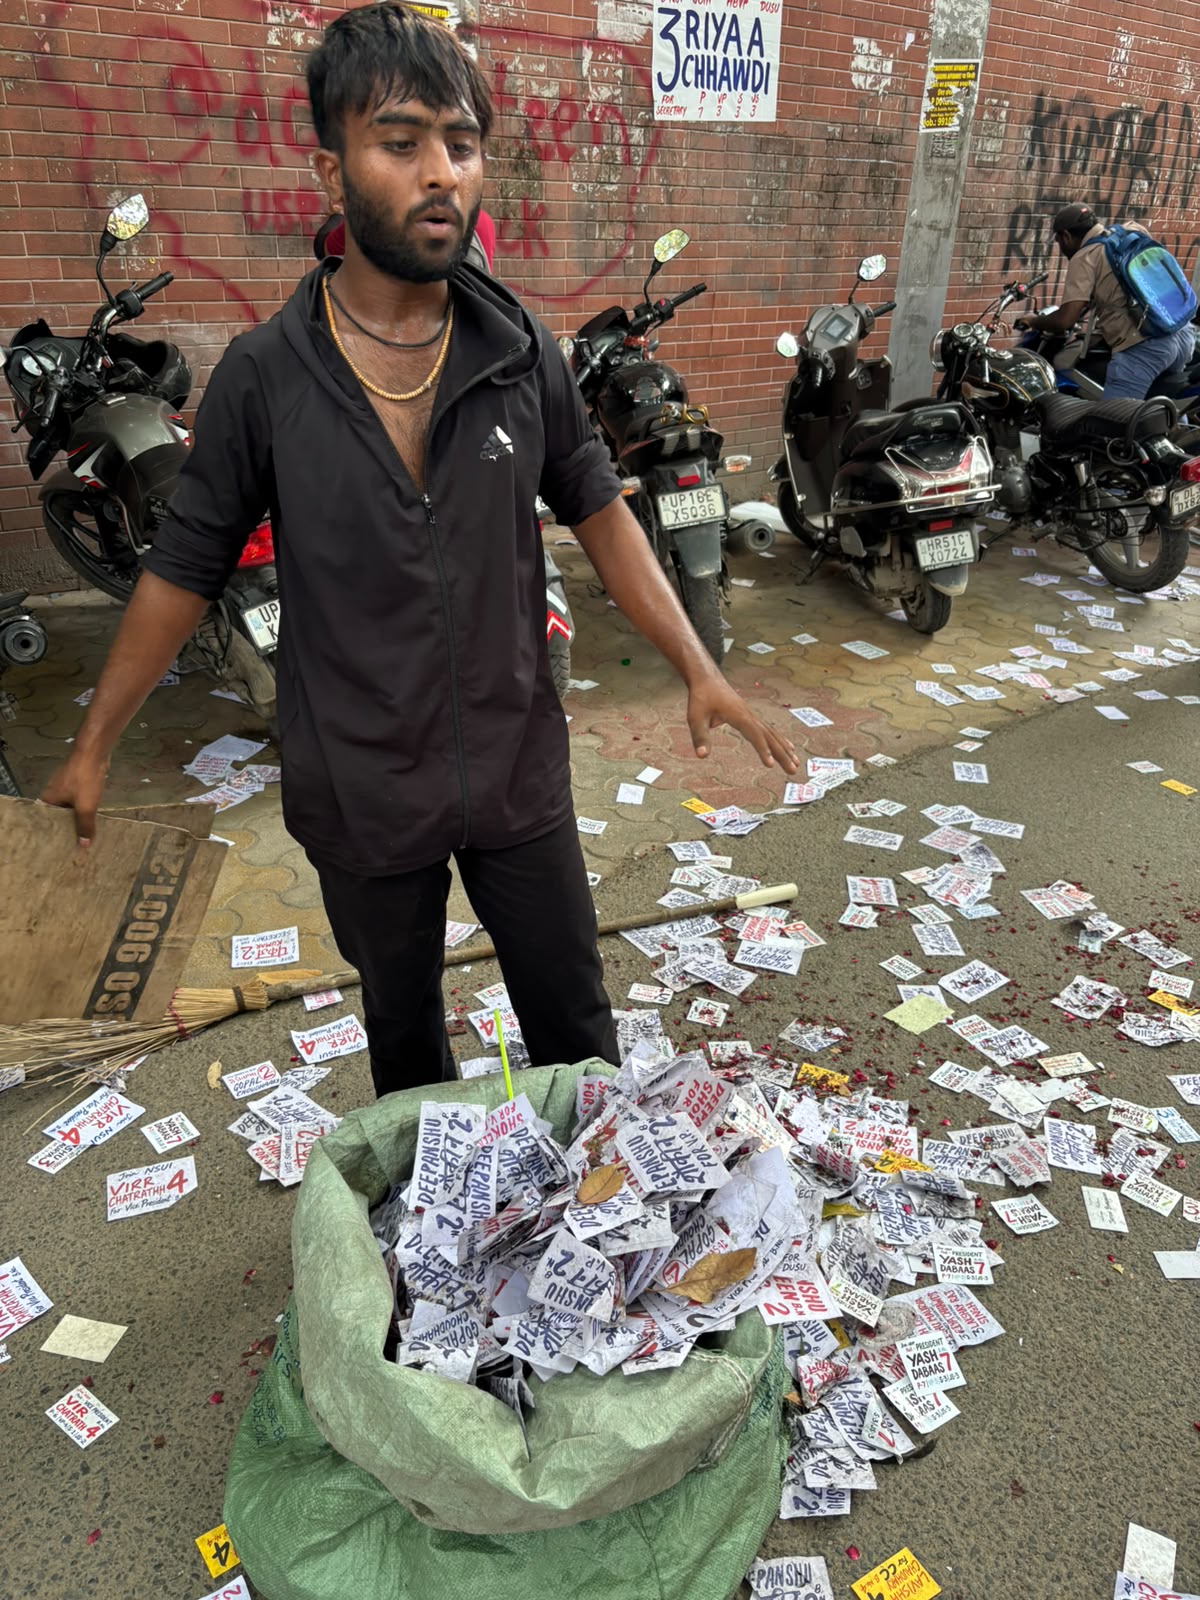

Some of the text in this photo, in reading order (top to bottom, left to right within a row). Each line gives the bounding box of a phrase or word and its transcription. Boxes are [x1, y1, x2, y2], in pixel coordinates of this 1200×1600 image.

[657, 7, 681, 92] 3
[682, 54, 770, 95] CHHAWDI
[661, 95, 674, 104] FOR
[656, 105, 687, 116] SECRETARY
[669, 489, 714, 508] UP16E
[673, 504, 717, 523] X5036
[926, 533, 966, 550] HR51C
[929, 546, 968, 564] X0724
[241, 946, 253, 960] 2
[256, 940, 283, 949] KUMAR
[479, 1019, 494, 1036] 4
[299, 1033, 364, 1055] VIRR 4
[319, 1049, 341, 1060] NSUI
[259, 1066, 274, 1080] 2
[954, 1067, 969, 1077] 3
[233, 1077, 261, 1092] GOPAL
[683, 1079, 700, 1107] FOR
[499, 1102, 516, 1121] FOR
[694, 1082, 725, 1127] DEEPA
[57, 1104, 131, 1146] VIRR 4
[164, 1118, 183, 1136] YASH
[297, 1126, 325, 1138] 2
[448, 1118, 473, 1133] 2
[649, 1115, 677, 1136] 2
[889, 1128, 910, 1137] FOR
[90, 1126, 113, 1145] NSUI
[166, 1135, 183, 1144] 7
[38, 1156, 56, 1168] 3
[417, 1118, 442, 1205] DEEPANSHU
[509, 1127, 549, 1184] DEEPANS
[692, 1145, 717, 1168] FOR
[144, 1162, 173, 1175] NSUI
[980, 1162, 991, 1176] 2
[110, 1169, 188, 1196] VIRR 4
[1135, 1179, 1164, 1196] YASH
[108, 1185, 165, 1208] CHATRATHH
[141, 1195, 171, 1208] President
[435, 1213, 464, 1230] 2
[1005, 1211, 1047, 1225] YASH 7
[679, 1223, 715, 1264] GOPAL
[553, 1249, 575, 1277] 2
[782, 1253, 800, 1262] FOR
[939, 1254, 972, 1266] YASH
[782, 1264, 807, 1272] DUSU
[940, 1262, 985, 1275] DABAAS 7
[764, 1302, 790, 1317] 2
[966, 1301, 990, 1325] SINGH
[446, 1319, 479, 1348] GOPAL
[972, 1327, 985, 1337] 3
[916, 1337, 945, 1351] PRESIDENT
[907, 1349, 939, 1367] YASH
[911, 1352, 952, 1381] DABAAS 7
[66, 1395, 88, 1418] VIR
[56, 1403, 101, 1439] CHATRATH 4
[93, 1407, 113, 1425] PRESIDENT
[830, 1390, 877, 1451] DEEPANS
[792, 1496, 820, 1511] 2
[212, 1541, 230, 1567] 4
[880, 1563, 897, 1581] CC
